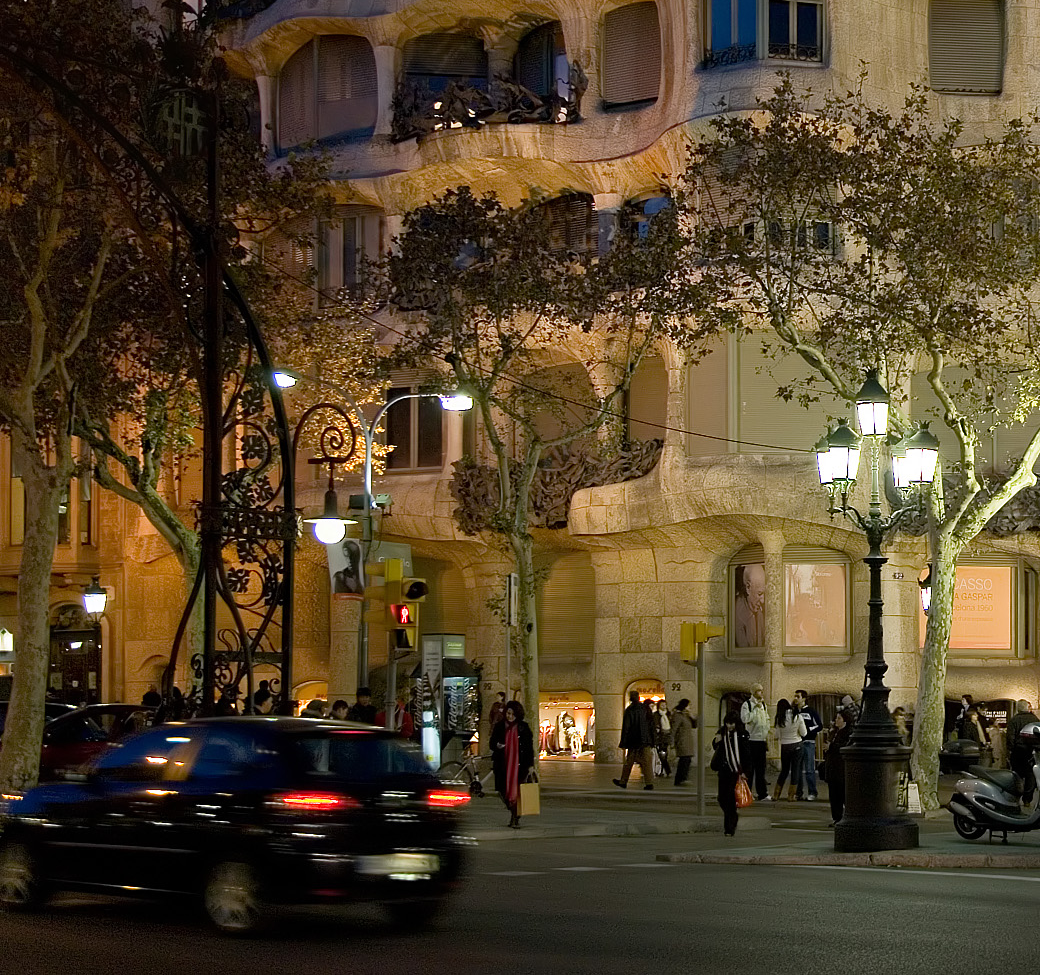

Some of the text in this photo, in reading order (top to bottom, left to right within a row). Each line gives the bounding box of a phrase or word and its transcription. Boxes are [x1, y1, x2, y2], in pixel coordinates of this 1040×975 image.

[954, 578, 993, 591] CASSO
[961, 593, 993, 601] GASPAR
[672, 683, 681, 691] 92
